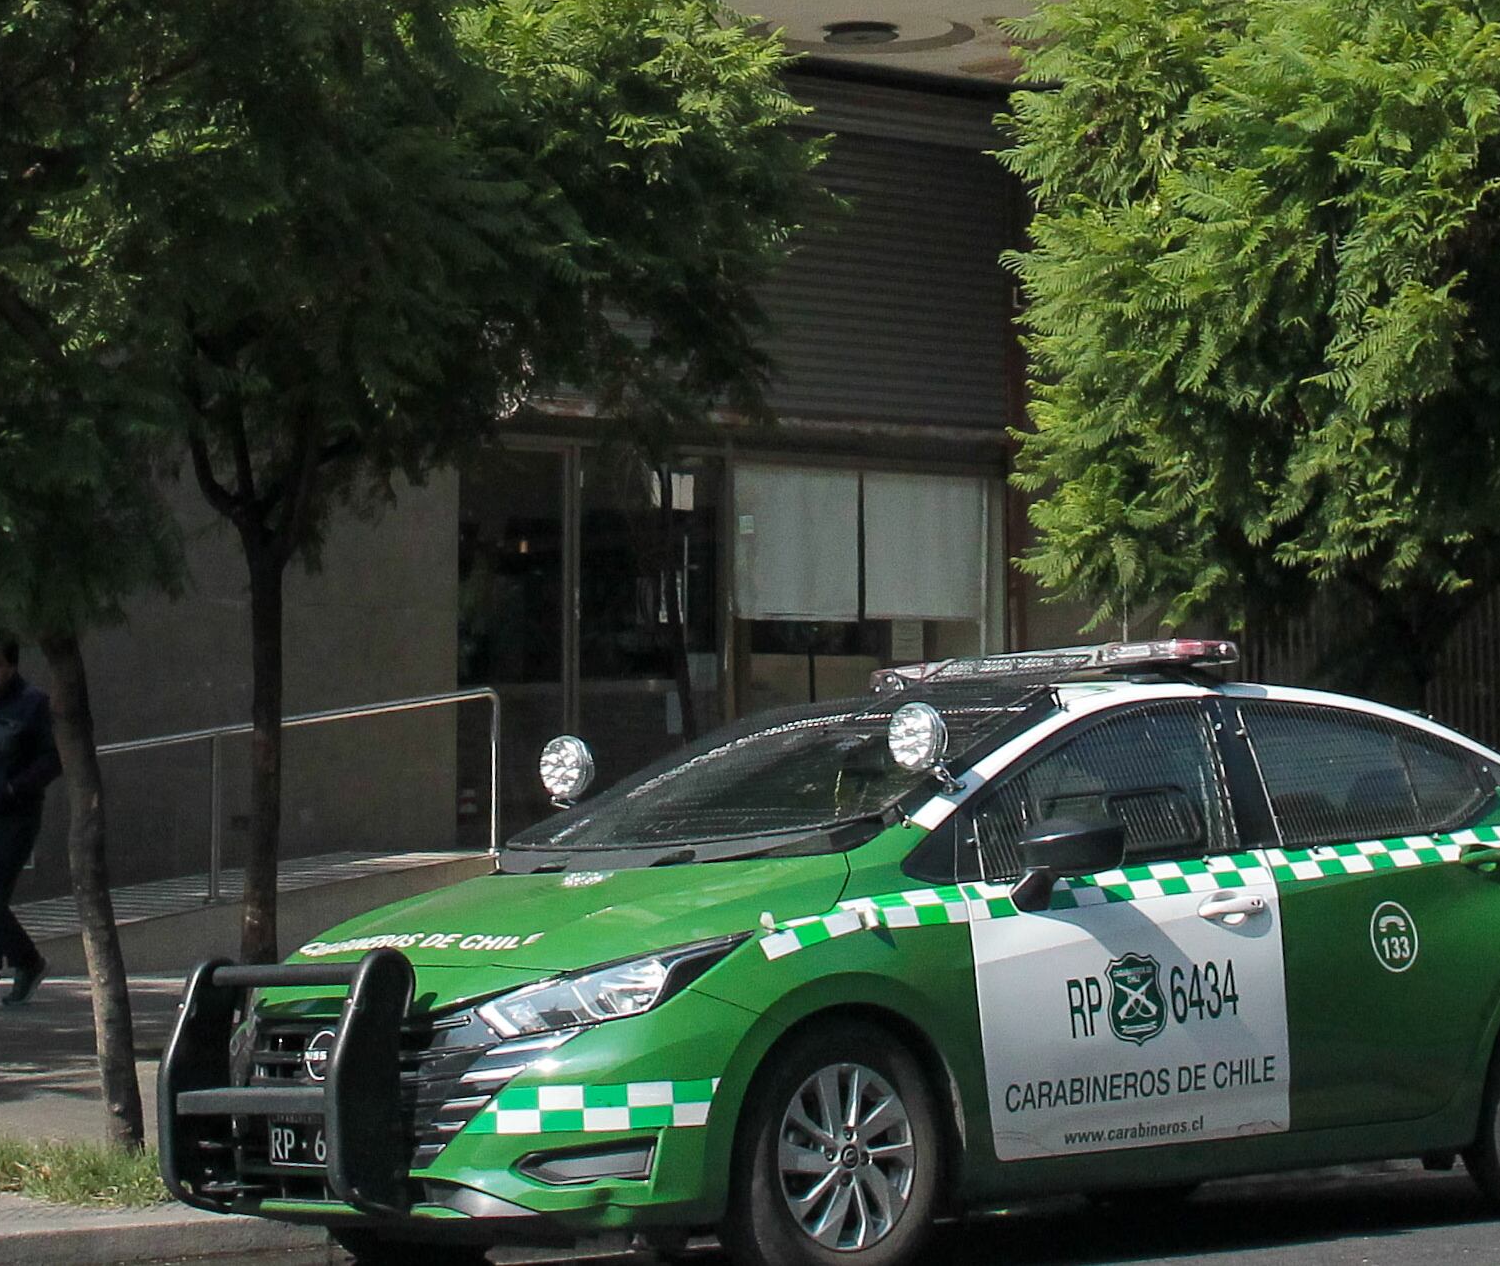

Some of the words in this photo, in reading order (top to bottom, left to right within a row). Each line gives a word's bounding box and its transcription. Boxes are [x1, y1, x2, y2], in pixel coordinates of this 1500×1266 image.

[419, 933, 462, 948] DE
[1382, 936, 1410, 960] 133
[1066, 976, 1102, 1038] RP
[1170, 959, 1239, 1024] 6434
[304, 1050, 328, 1061] NISS
[1005, 1067, 1170, 1113] CARABINEROS
[1178, 1064, 1206, 1093] DE
[1213, 1055, 1276, 1089] CHILE
[272, 1128, 295, 1160] RP
[1064, 1116, 1204, 1145] www.carabineros.cl
